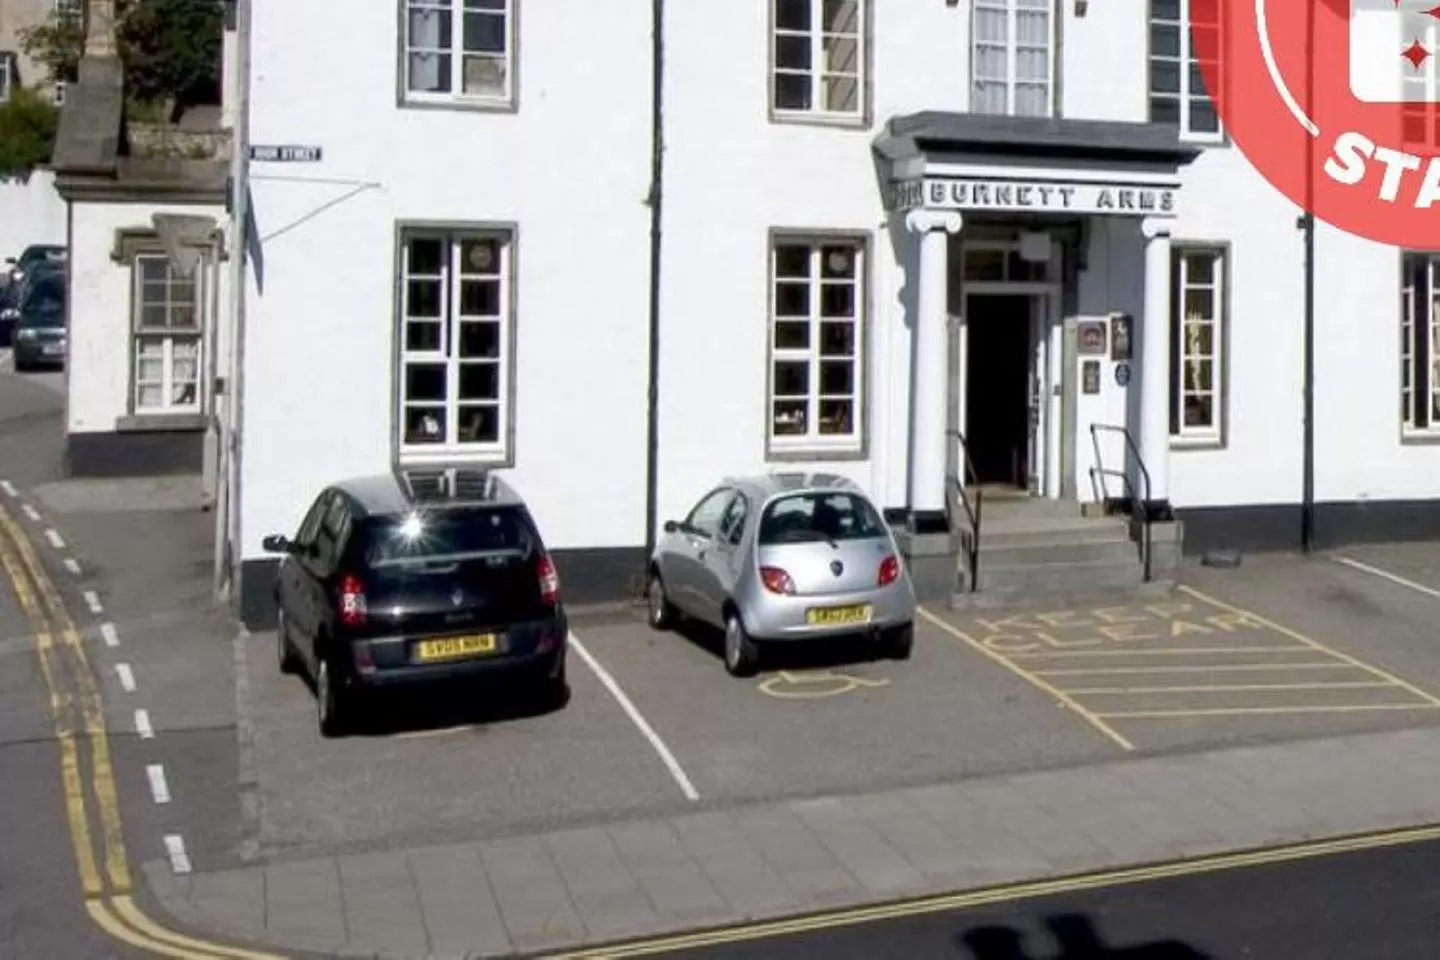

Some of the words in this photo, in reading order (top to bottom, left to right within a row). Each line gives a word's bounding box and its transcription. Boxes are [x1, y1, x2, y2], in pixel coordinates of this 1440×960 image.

[930, 182, 1076, 208] BURNETT
[1096, 188, 1174, 211] ARMS
[976, 605, 1193, 632] KEEP
[982, 614, 1264, 651] CLEAR
